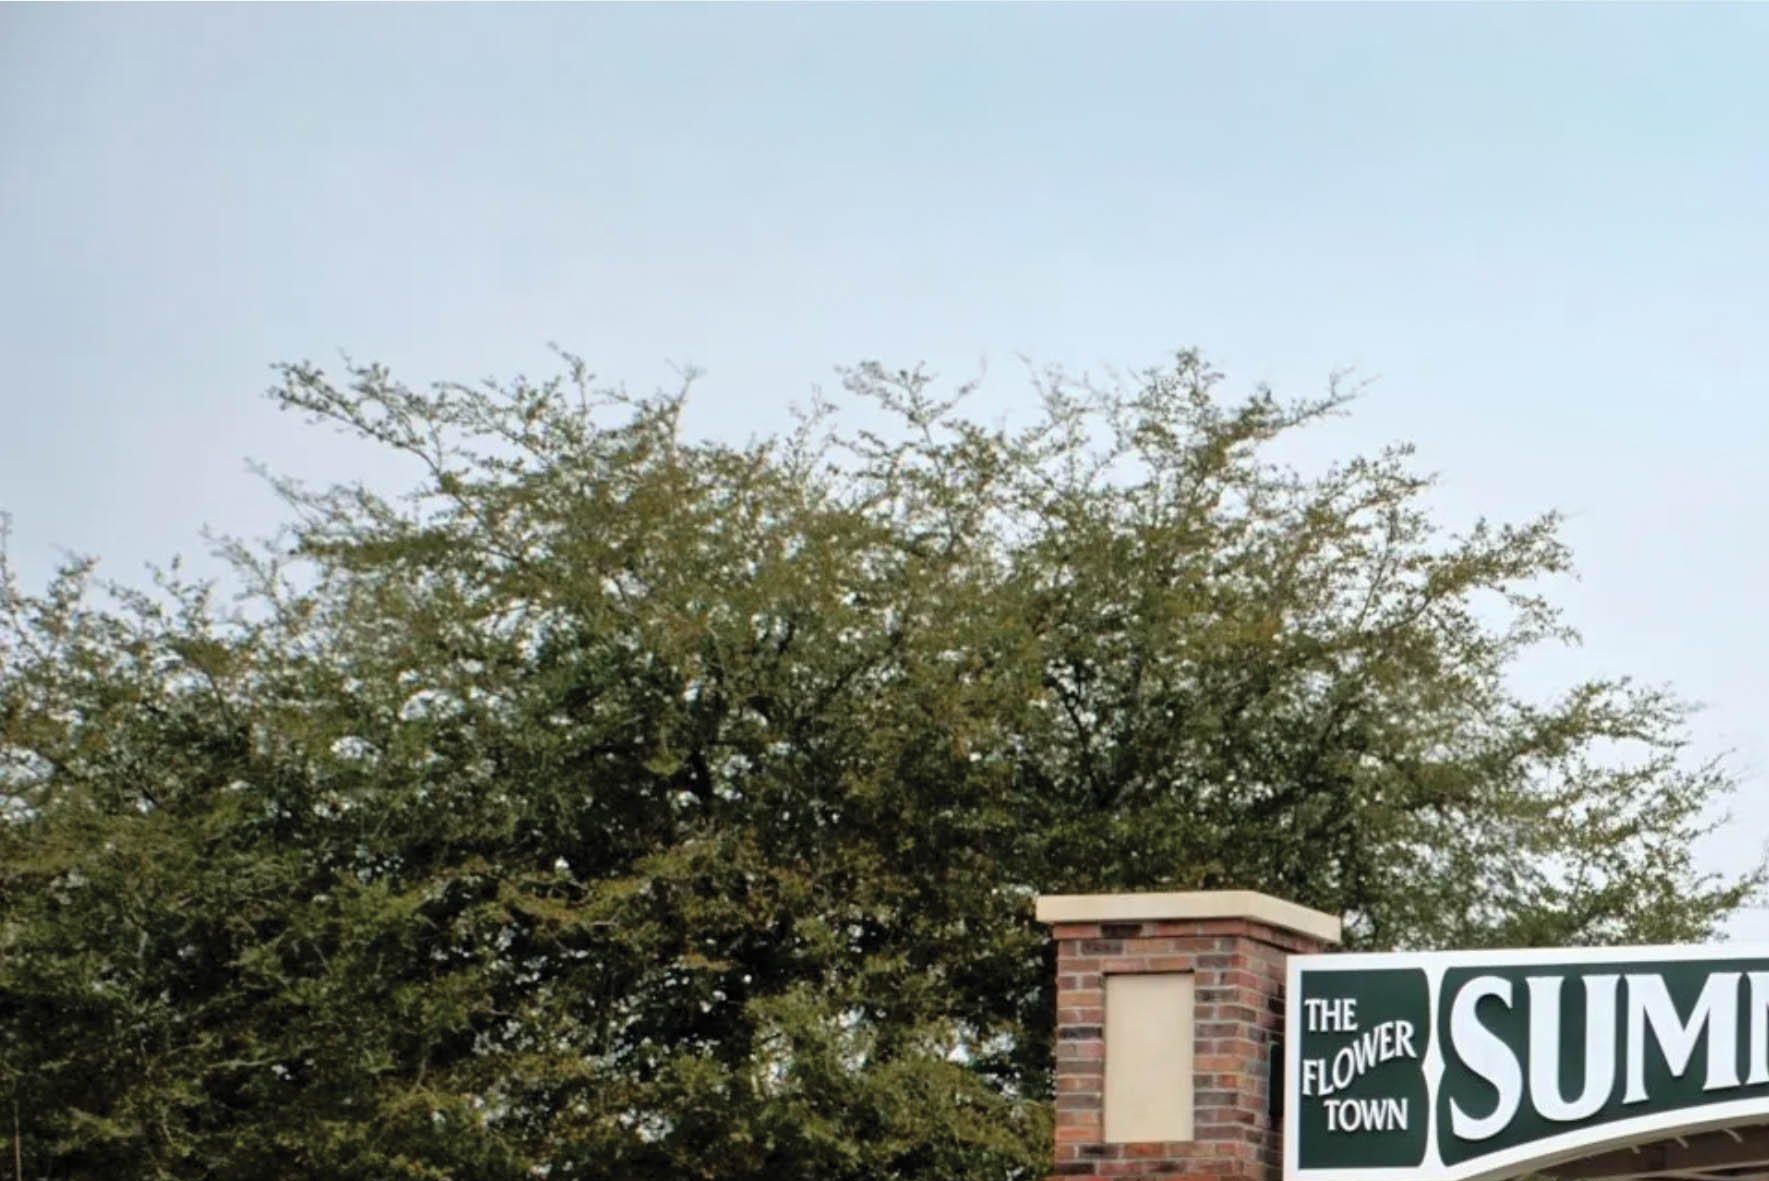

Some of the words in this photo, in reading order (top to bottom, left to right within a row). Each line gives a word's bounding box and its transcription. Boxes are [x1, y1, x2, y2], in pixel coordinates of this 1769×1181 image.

[1304, 998, 1359, 1031] THE
[1302, 1019, 1417, 1096] FLOWER
[1323, 1098, 1408, 1132] TOWN
